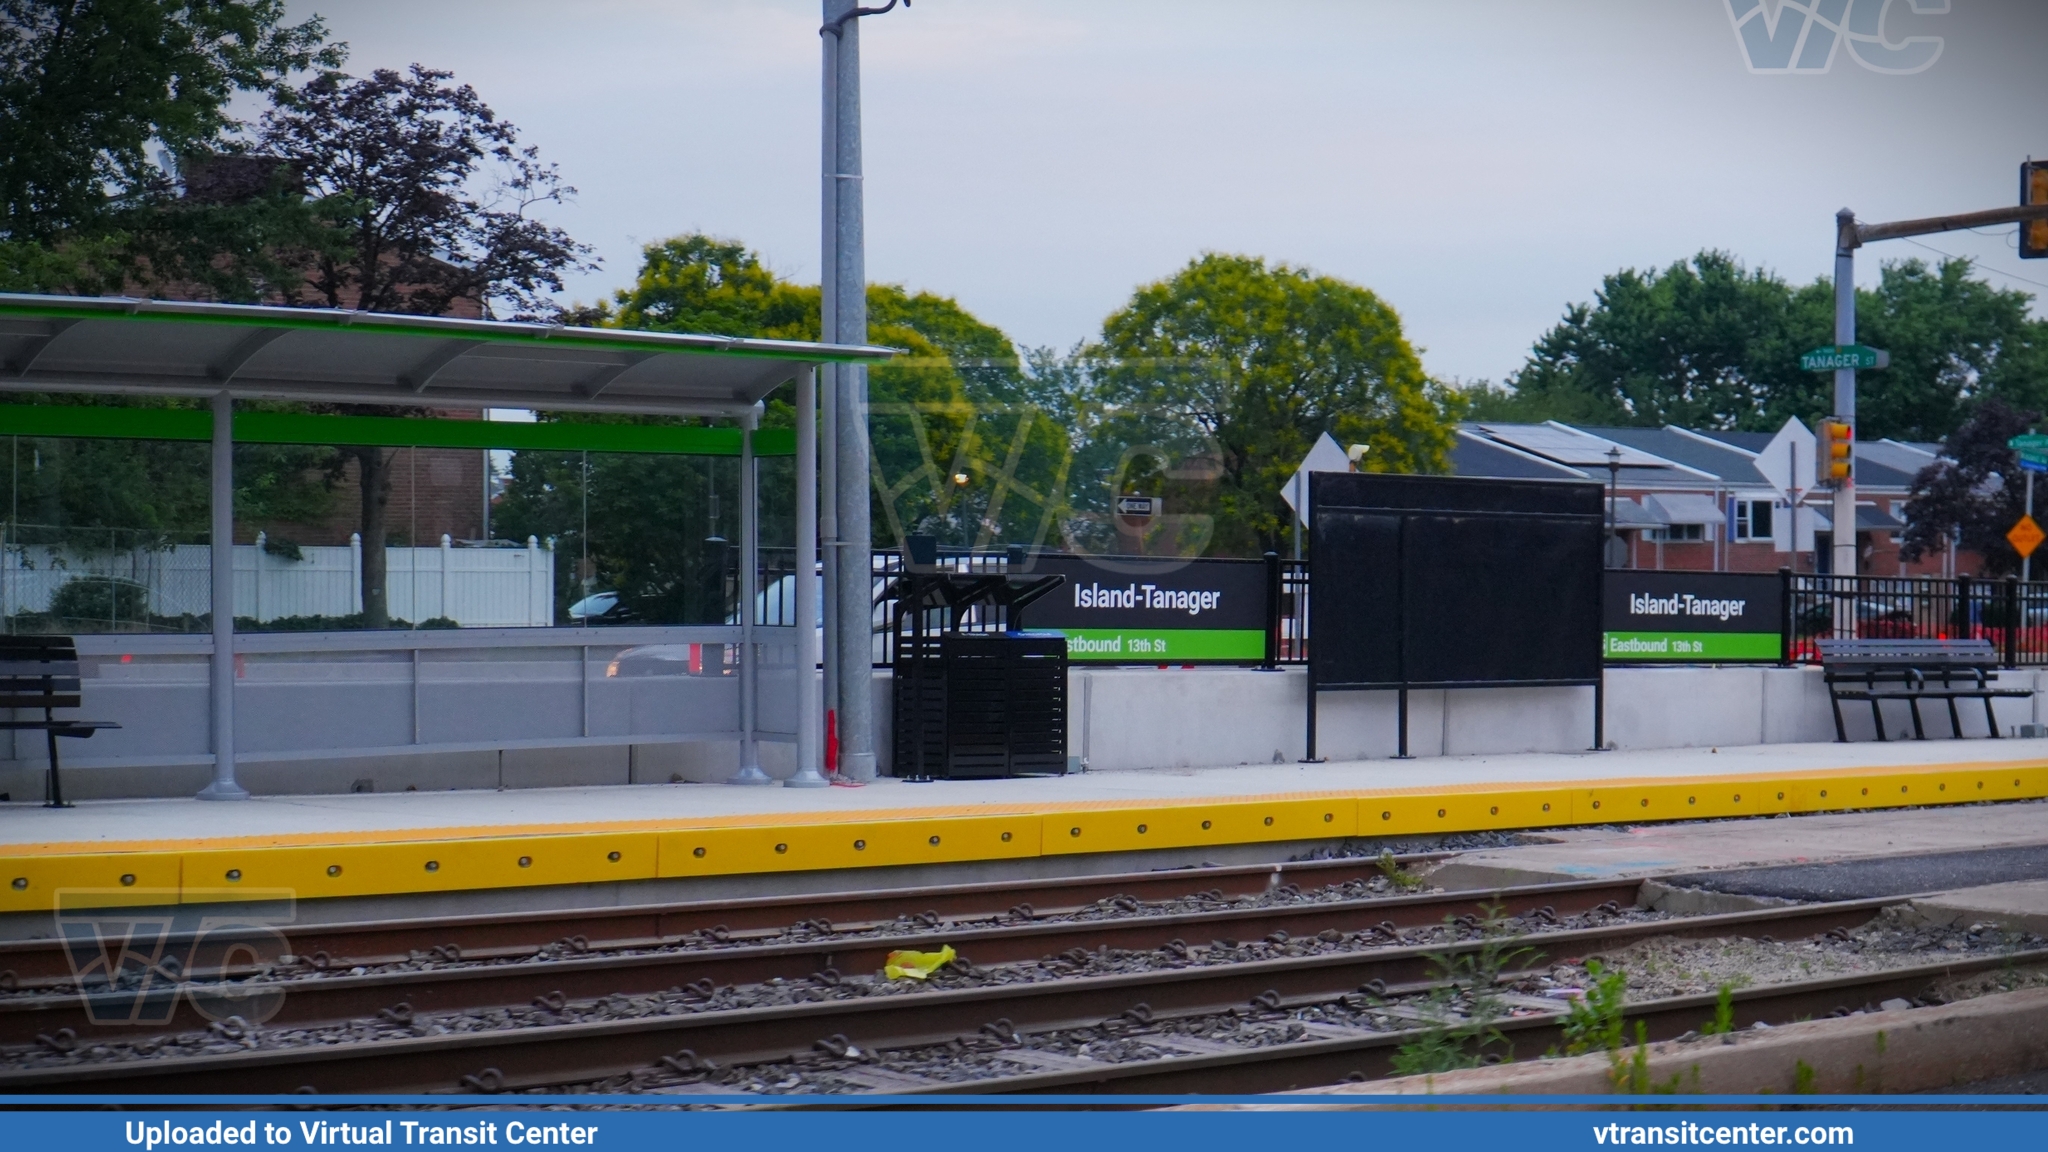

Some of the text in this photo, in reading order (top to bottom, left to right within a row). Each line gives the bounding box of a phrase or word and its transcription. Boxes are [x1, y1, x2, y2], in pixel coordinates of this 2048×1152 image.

[1801, 354, 1874, 369] TANAGER ST
[1074, 582, 1221, 615] Island-Tanager
[1630, 592, 1746, 621] Island-Tanager
[1067, 635, 1166, 652] stbound 13th St
[1610, 638, 1667, 652] Eastbound
[1672, 641, 1691, 652] 13th
[1692, 641, 1703, 652] St
